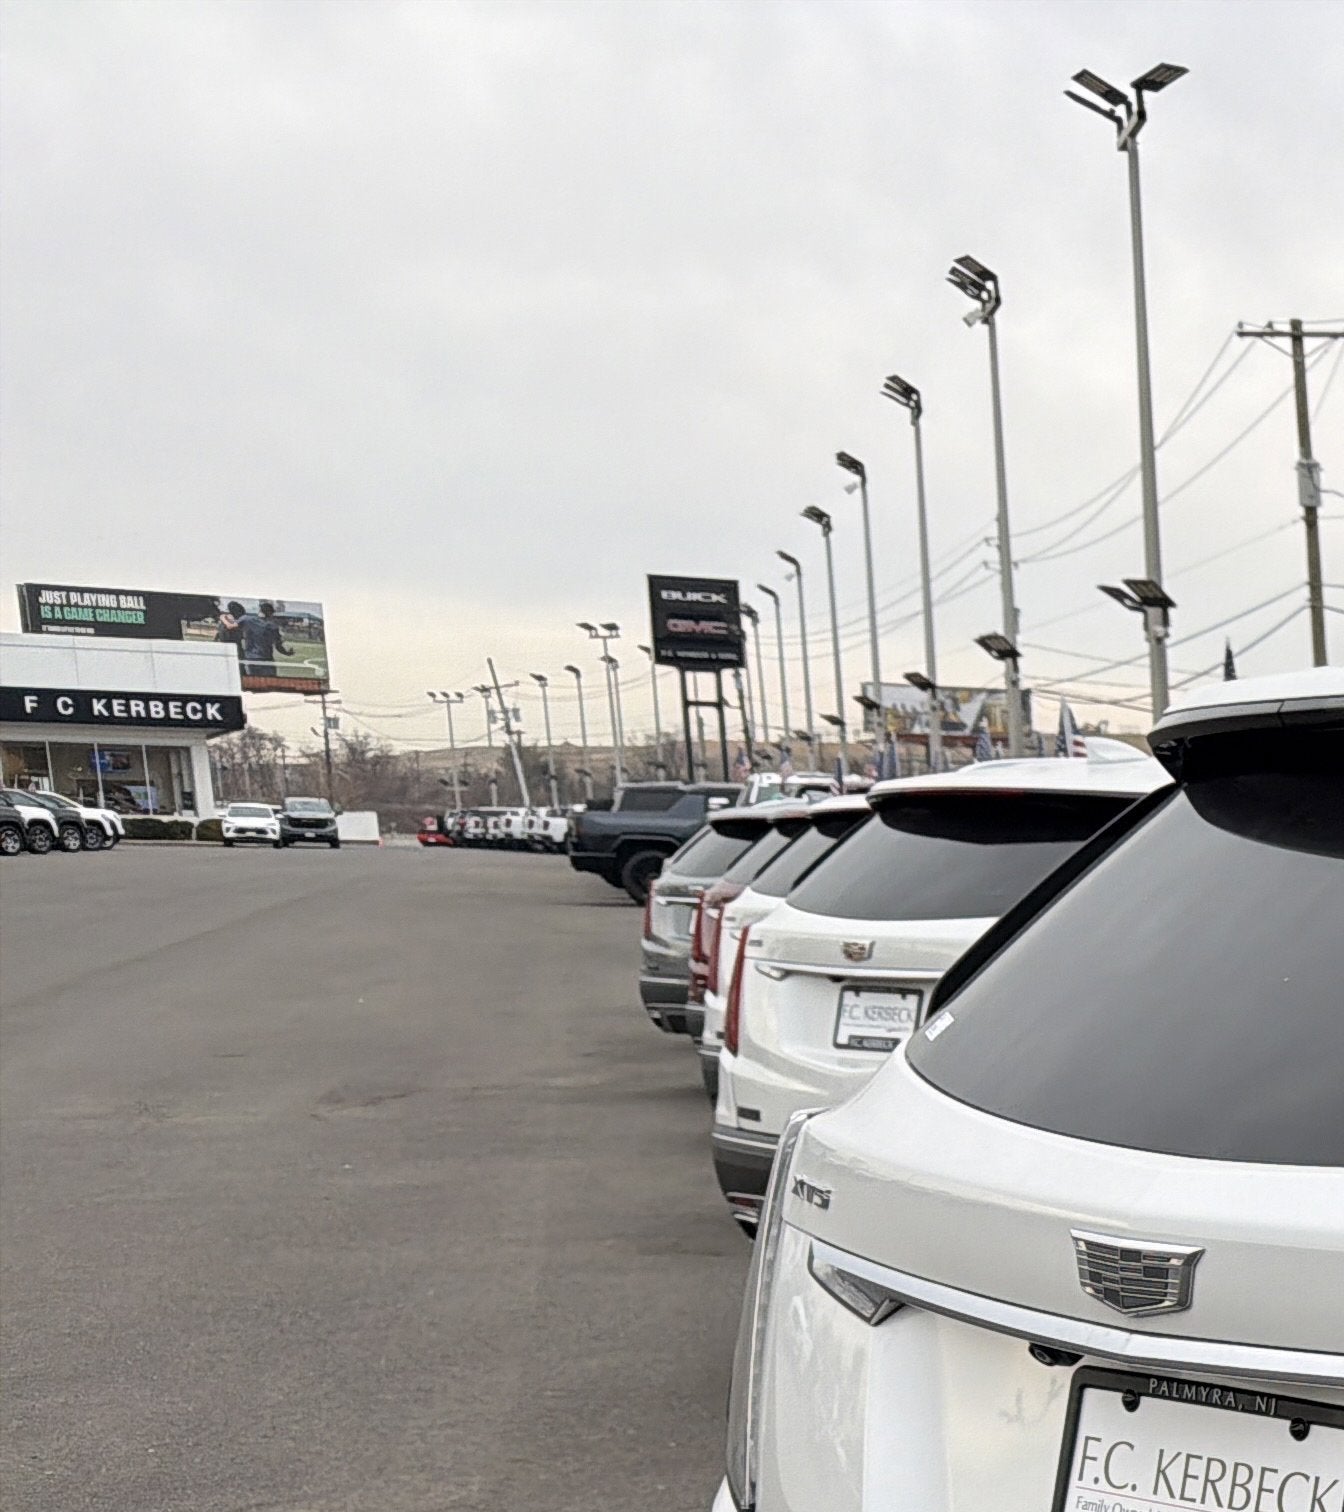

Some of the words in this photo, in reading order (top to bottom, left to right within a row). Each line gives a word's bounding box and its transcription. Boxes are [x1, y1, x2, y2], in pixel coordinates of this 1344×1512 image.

[38, 590, 67, 605] JUST
[69, 591, 118, 608] PLAYING
[120, 594, 146, 610] BALL
[660, 589, 728, 604] BUICK
[40, 605, 52, 619] IS
[54, 606, 62, 620] A
[63, 607, 95, 622] GAME
[96, 608, 146, 625] CHANGER
[666, 618, 729, 635] GMC
[24, 695, 39, 714] F
[56, 696, 75, 716] C
[92, 697, 224, 721] KERBECK
[1149, 1377, 1244, 1412] PALMYRA,
[1255, 1396, 1279, 1416] NJ
[1077, 1434, 1139, 1493] F.C.
